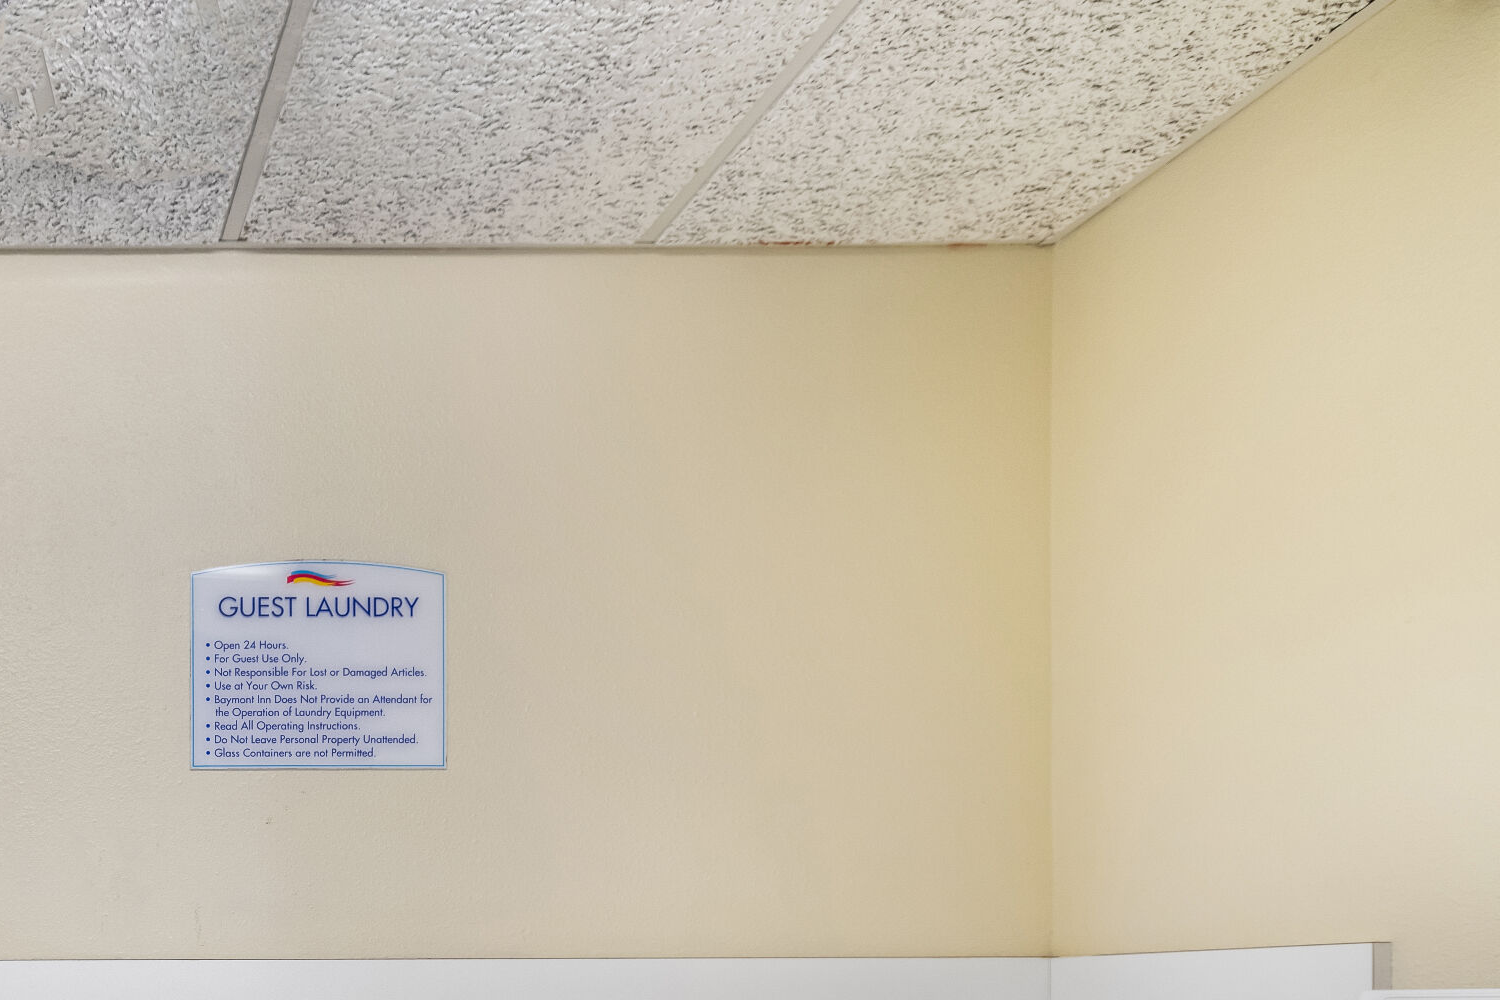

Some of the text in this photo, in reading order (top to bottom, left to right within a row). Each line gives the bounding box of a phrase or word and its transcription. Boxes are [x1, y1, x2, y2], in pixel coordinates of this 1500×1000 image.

[219, 596, 419, 618] GUEST LAUNDRY
[214, 640, 289, 652] Open 24 Hours.
[215, 653, 307, 664] For Guest Use Only.
[215, 668, 231, 676] Not
[235, 666, 289, 679] Responsible
[292, 667, 307, 676] For
[310, 668, 327, 676] Lost
[343, 666, 387, 679] Damaged
[391, 667, 426, 676] Articles.
[215, 680, 317, 690] Use at Your Own Risk.
[215, 695, 254, 706] Baymont
[258, 695, 271, 703] Inn
[275, 695, 297, 703] Does
[301, 695, 317, 704] Not
[321, 694, 354, 703] Provide
[372, 693, 417, 703] Attendant
[420, 694, 432, 703] for
[216, 706, 385, 719] the Operation of Laundry Equipment.
[215, 720, 360, 733] Read All Operating Instructions.
[215, 734, 418, 746] Do Not Leave Personal Property Unattended.
[215, 747, 239, 757] Glass
[243, 748, 292, 757] Containers
[314, 749, 328, 757] not
[332, 747, 376, 757] Permitted.
